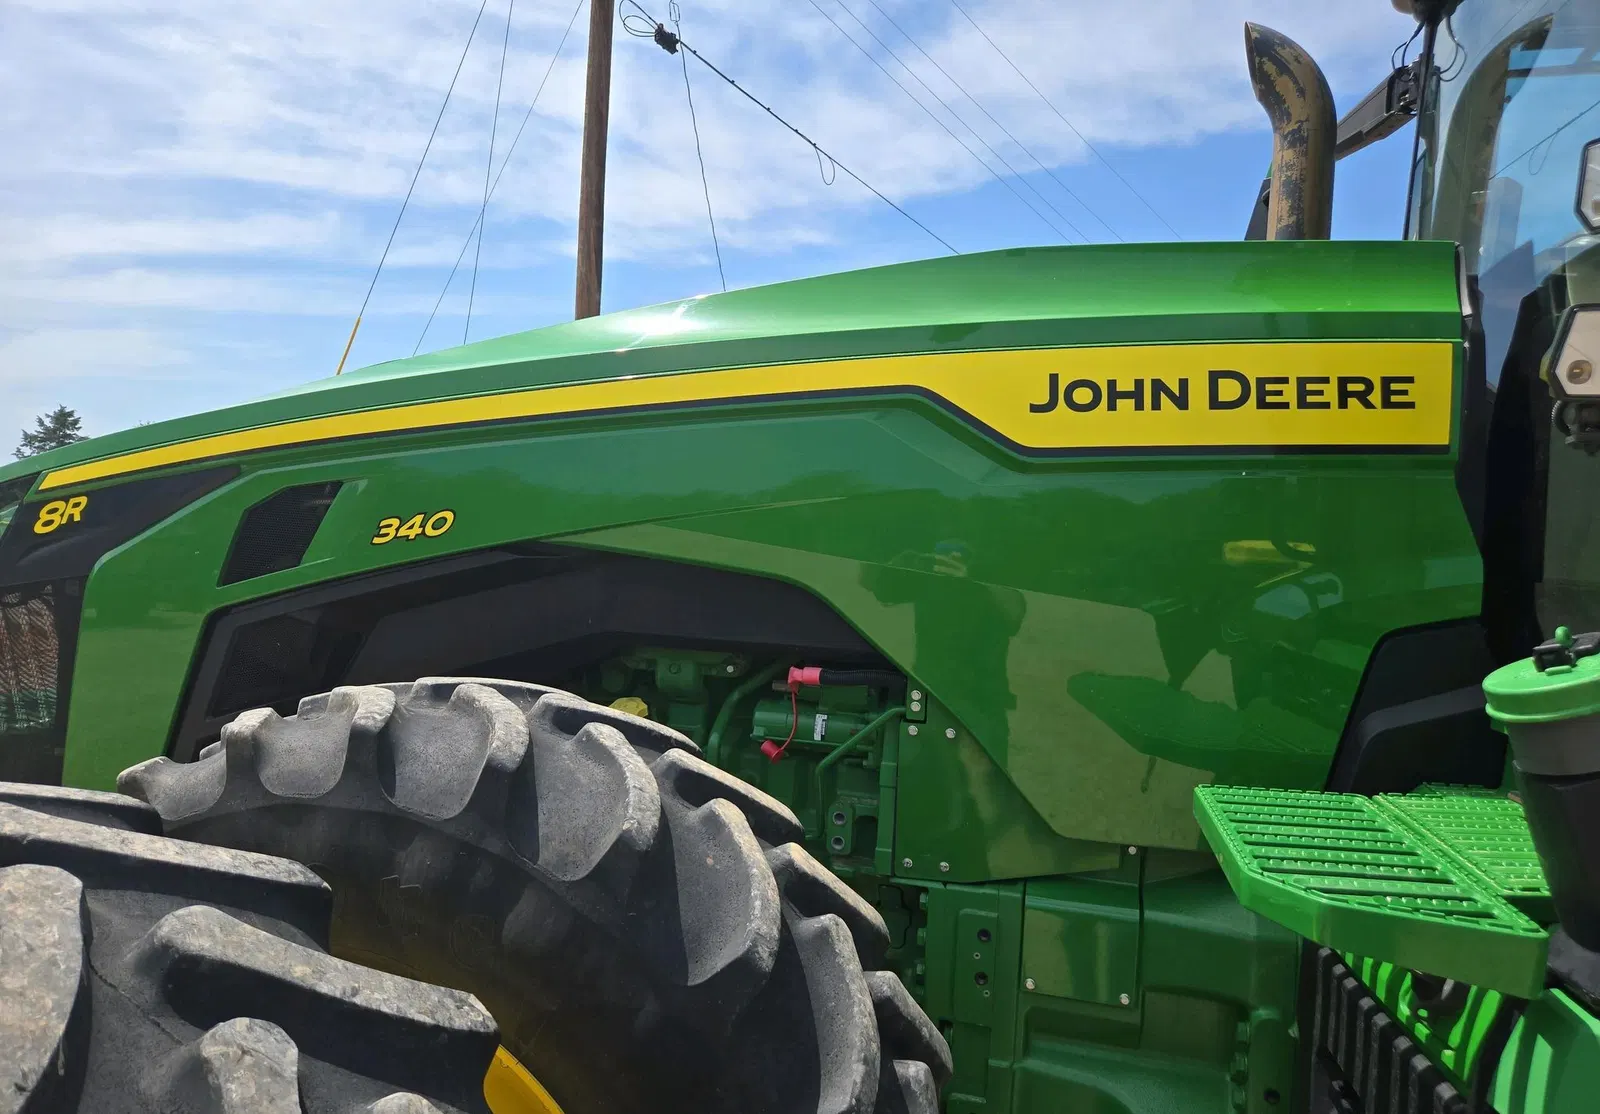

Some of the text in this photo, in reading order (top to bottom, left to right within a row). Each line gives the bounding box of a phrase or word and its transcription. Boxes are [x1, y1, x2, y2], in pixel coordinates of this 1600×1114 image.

[1029, 369, 1417, 414] JOHN DEERE
[33, 495, 88, 535] 8R
[370, 509, 456, 545] 340
